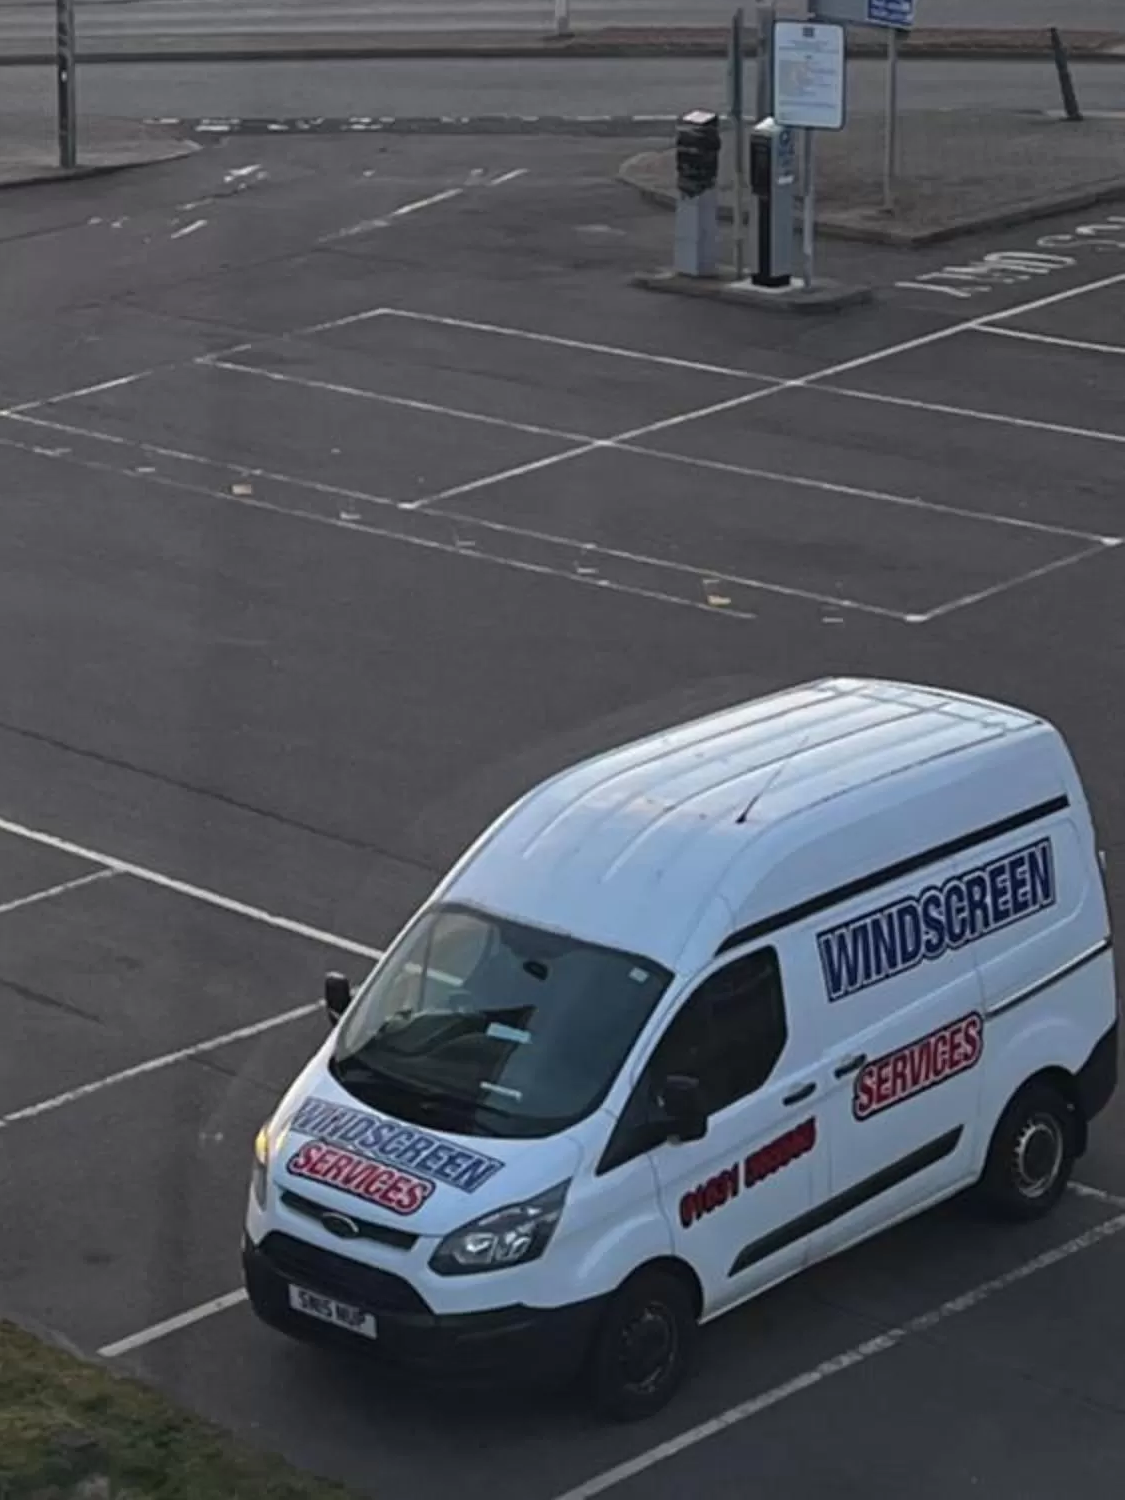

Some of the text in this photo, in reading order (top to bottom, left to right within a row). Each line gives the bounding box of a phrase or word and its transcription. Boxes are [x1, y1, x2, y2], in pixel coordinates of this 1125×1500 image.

[816, 836, 1056, 1002] WINDSCREEN
[854, 1011, 983, 1121] SERVICES
[286, 1140, 436, 1216] SERVICES
[291, 1097, 505, 1193] WINDSCREEN
